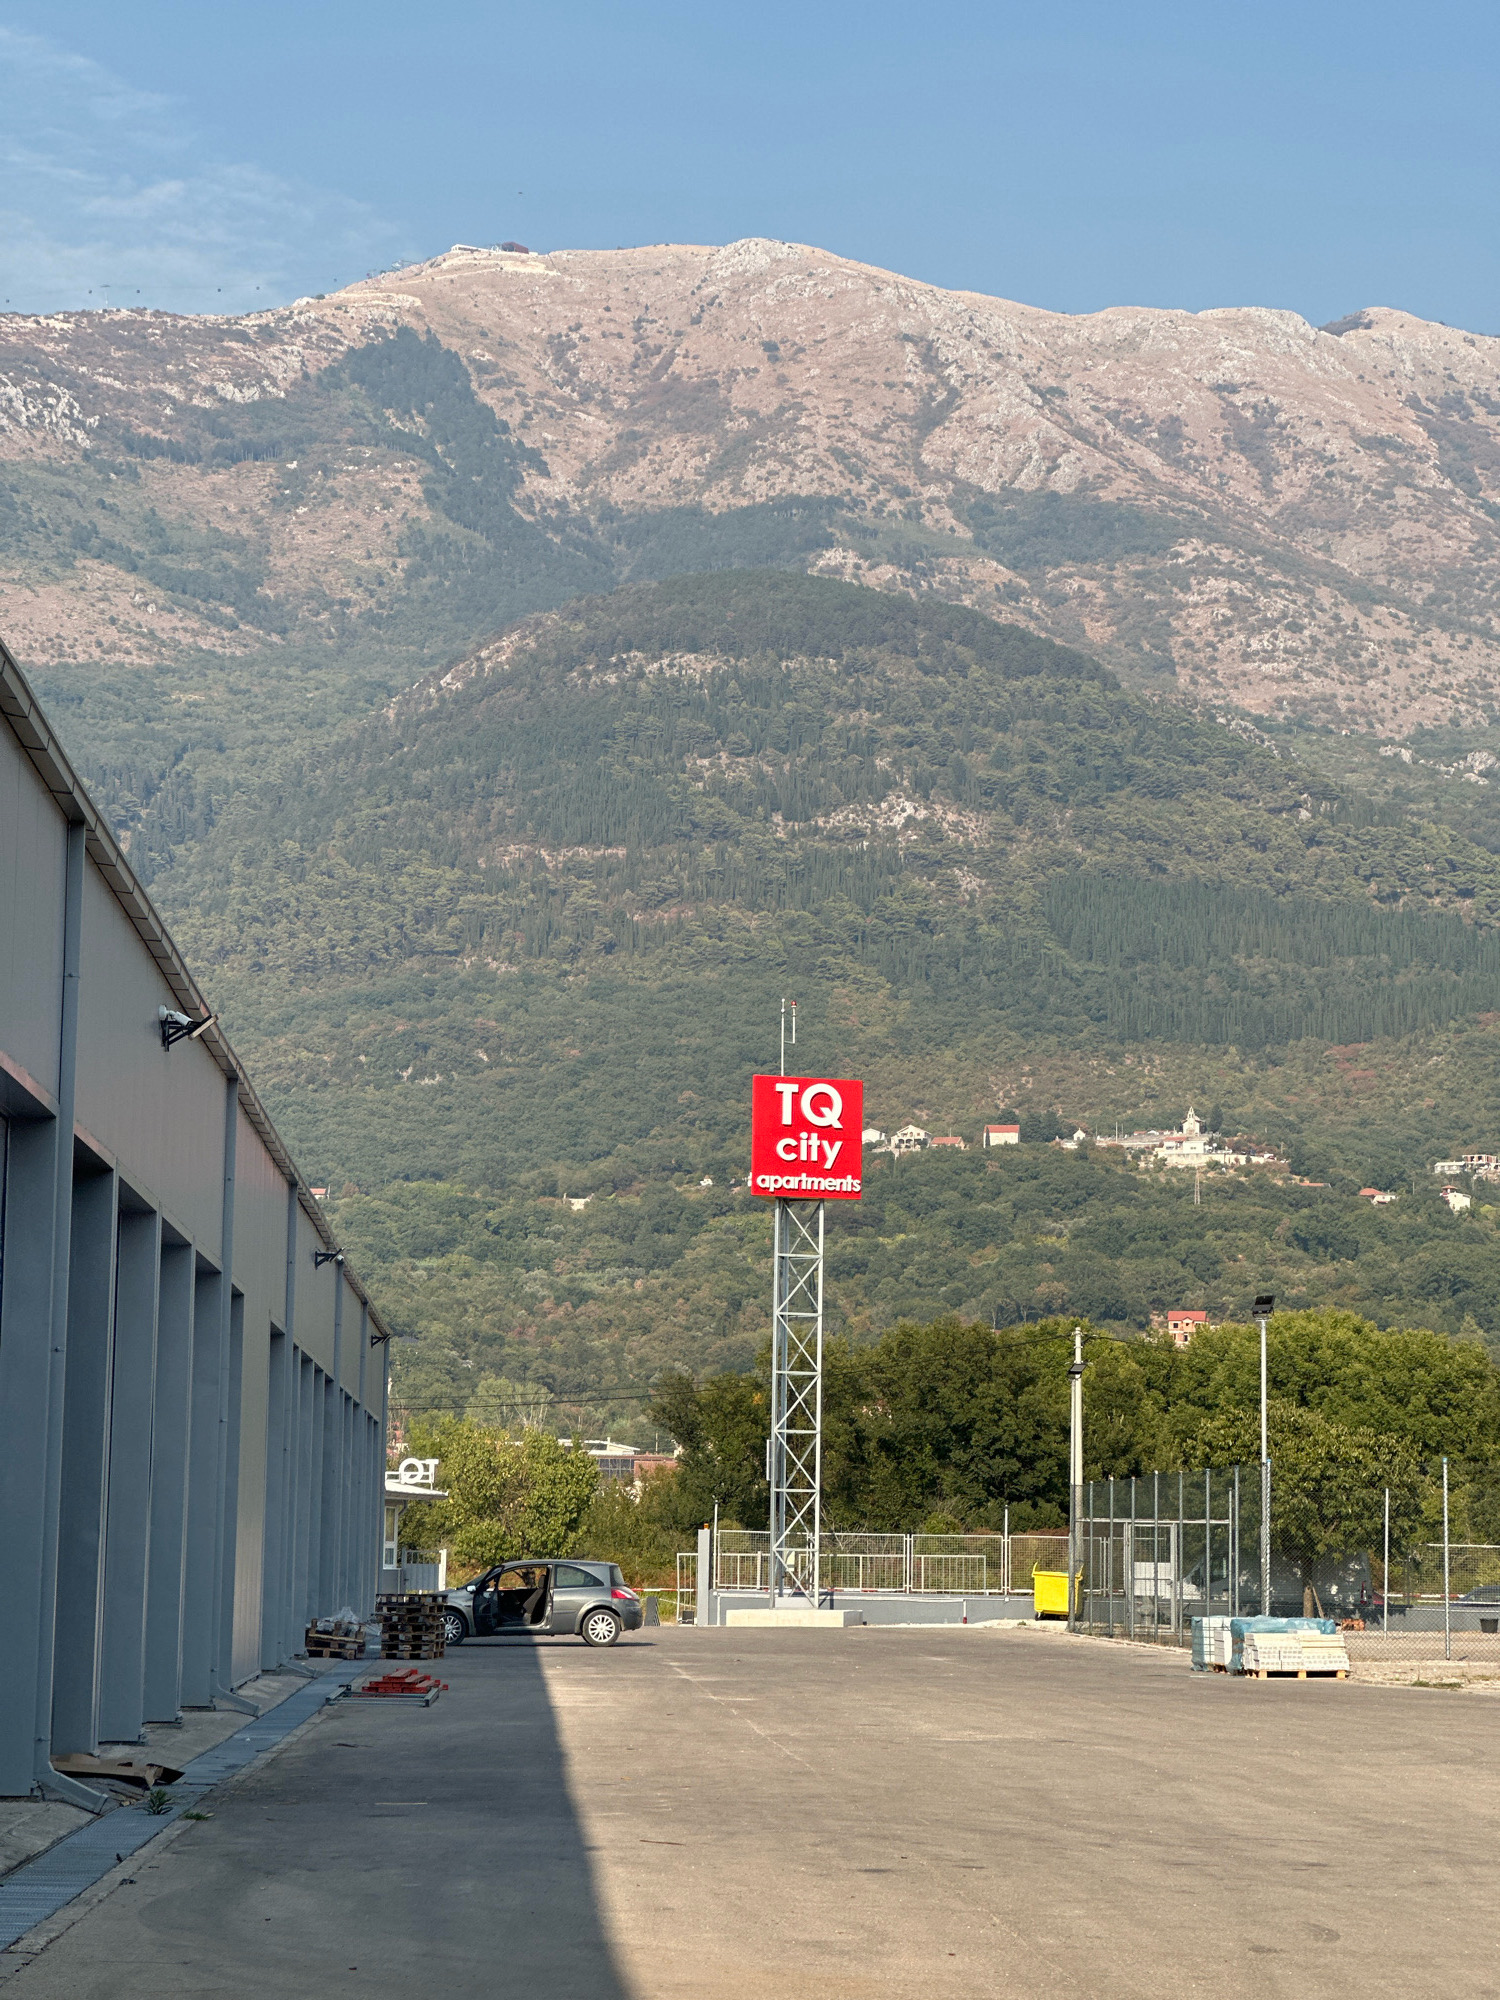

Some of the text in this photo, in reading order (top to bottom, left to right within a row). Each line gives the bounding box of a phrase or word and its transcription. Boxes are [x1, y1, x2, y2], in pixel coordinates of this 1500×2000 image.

[775, 1083, 843, 1129] TQ
[776, 1132, 843, 1170] city
[756, 1173, 862, 1193] apartments
